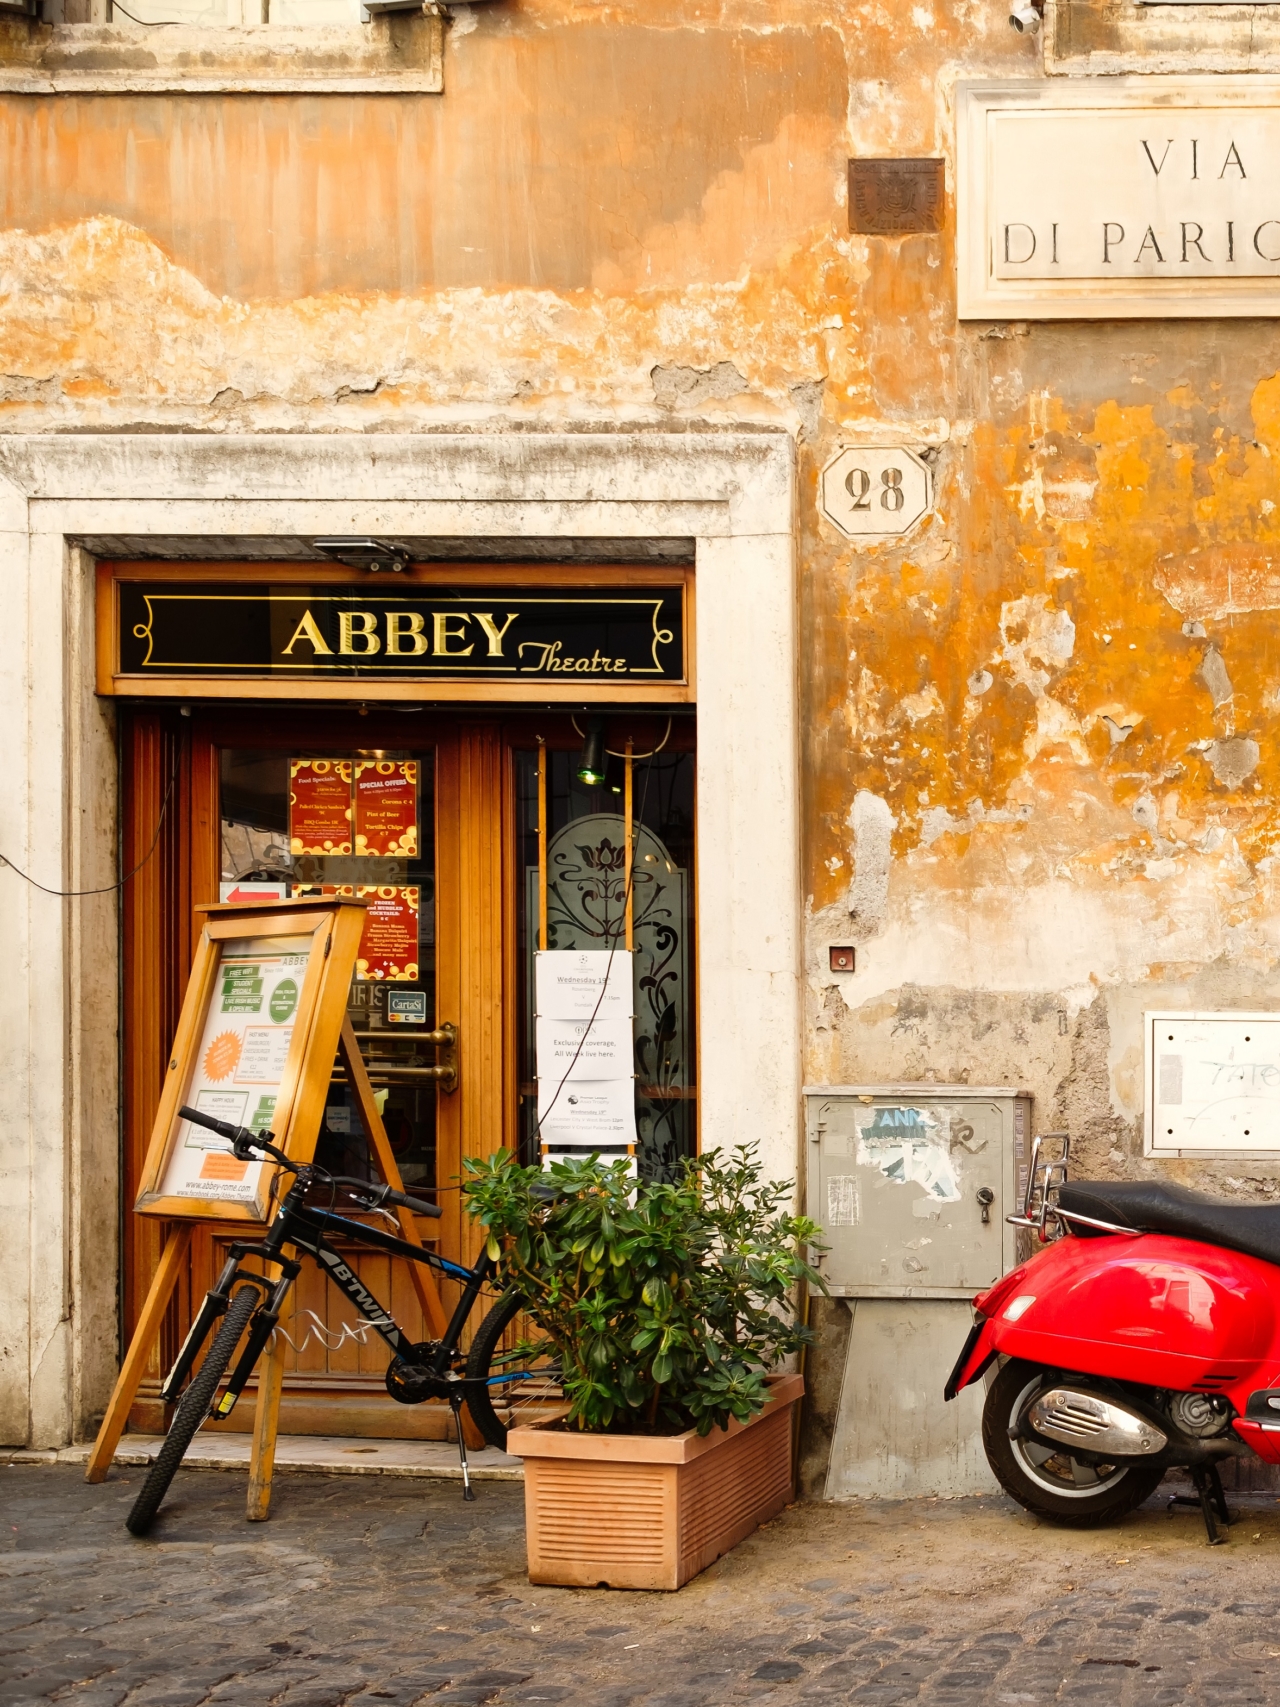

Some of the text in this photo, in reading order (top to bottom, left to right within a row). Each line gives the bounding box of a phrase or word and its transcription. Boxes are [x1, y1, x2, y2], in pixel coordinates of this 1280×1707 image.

[1139, 138, 1248, 180] VIA
[1003, 222, 1060, 264] DI
[844, 467, 905, 512] 28
[281, 607, 520, 658] ABBEY
[517, 640, 628, 673] Theatre
[359, 781, 384, 789] SPECIAL
[392, 998, 422, 1010] CartaSi
[186, 1181, 251, 1192] www.abbey-rome.com
